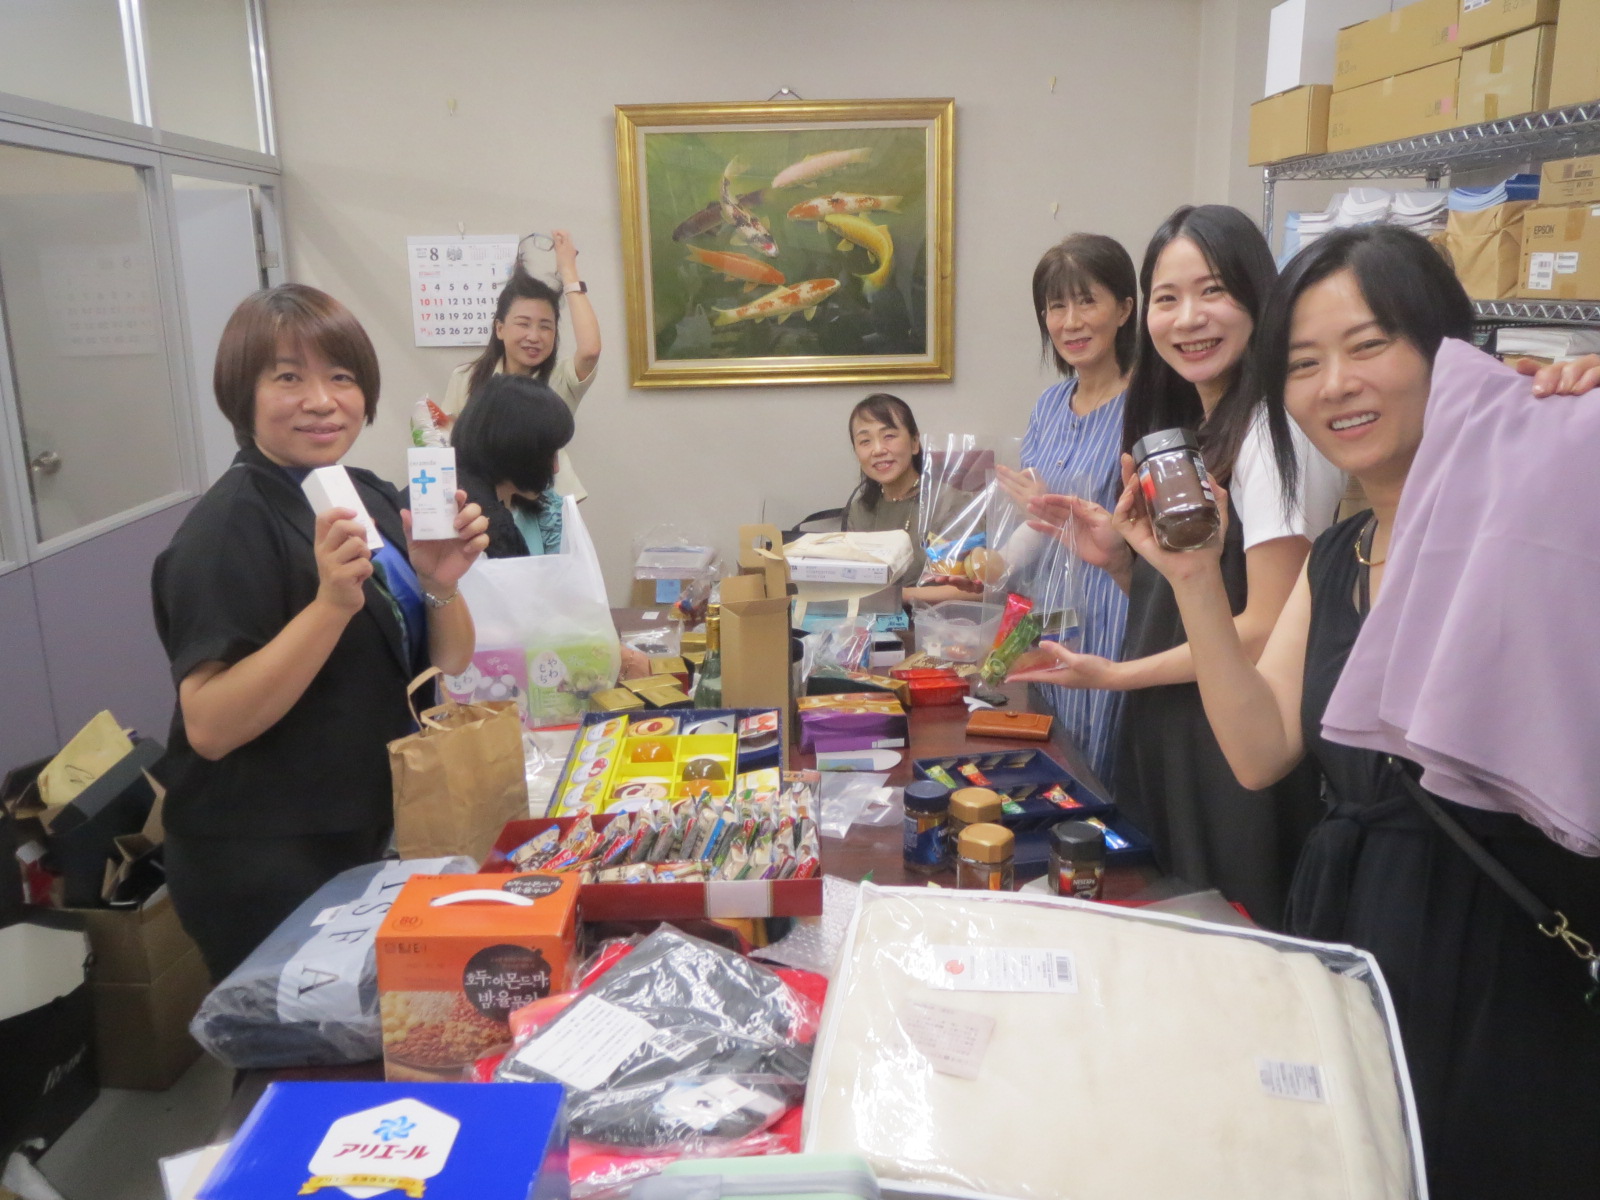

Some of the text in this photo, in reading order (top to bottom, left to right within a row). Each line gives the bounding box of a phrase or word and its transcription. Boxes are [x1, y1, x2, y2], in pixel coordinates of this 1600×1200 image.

[1533, 224, 1555, 235] EPSON
[430, 247, 439, 261] 8
[491, 267, 496, 276] 1
[421, 283, 427, 292] 3
[434, 283, 440, 291] 4
[449, 283, 454, 291] 5
[463, 283, 469, 291] 6
[491, 282, 497, 290] 8
[420, 298, 430, 306] 10
[433, 298, 443, 306] 11
[421, 313, 431, 321] 17
[449, 312, 459, 320] 19
[435, 327, 446, 335] 25
[477, 326, 488, 334] 28
[333, 1143, 431, 1160] アリエール
